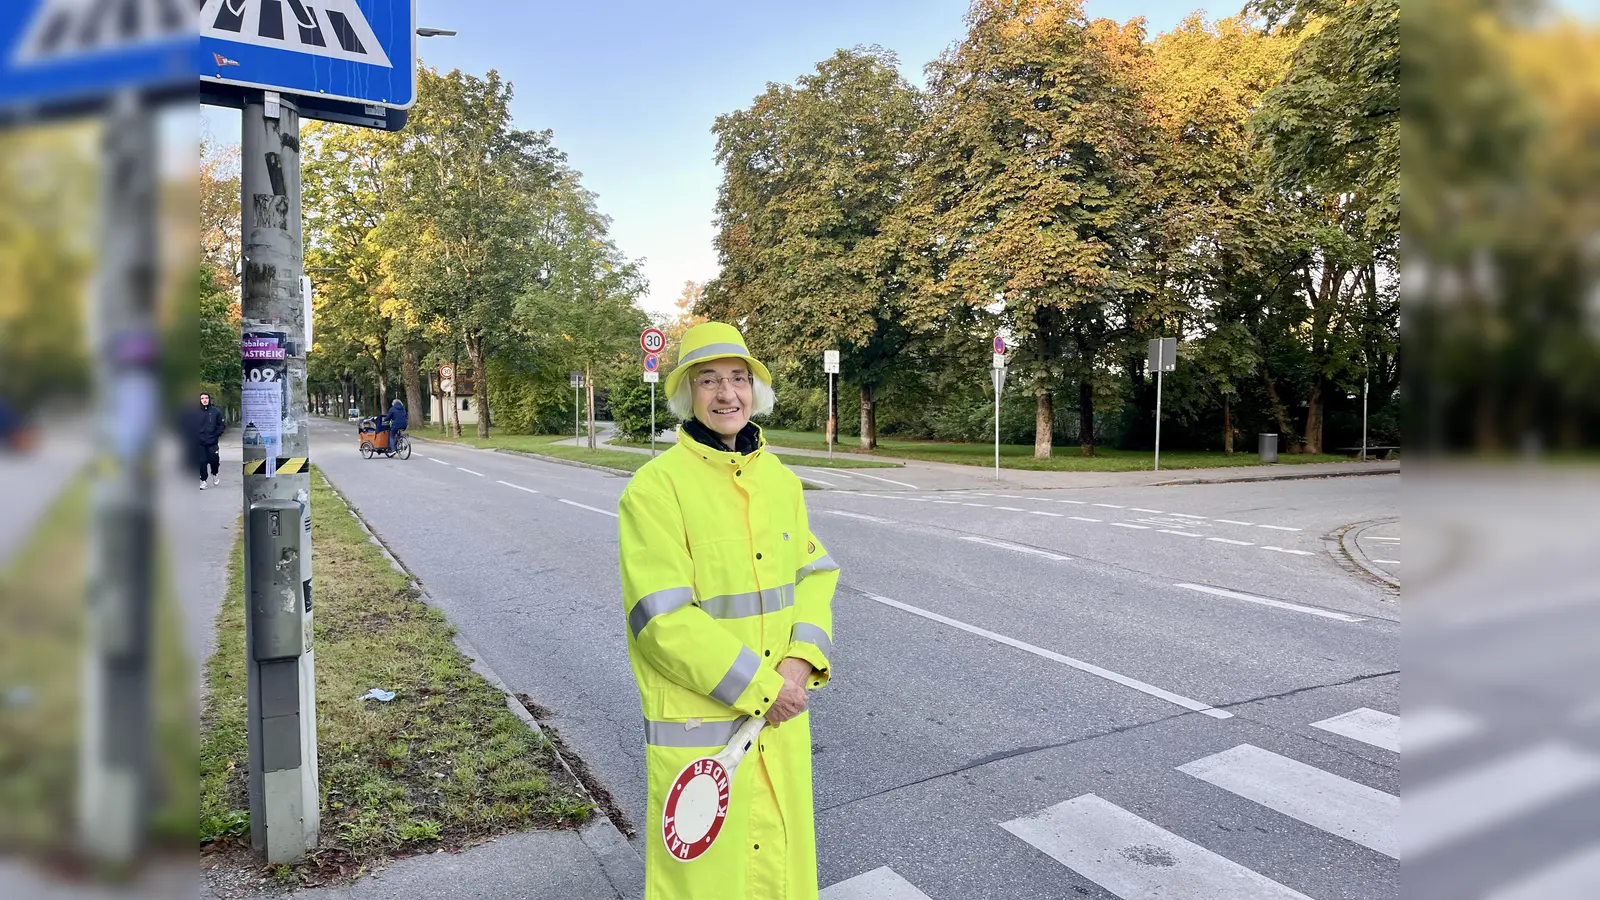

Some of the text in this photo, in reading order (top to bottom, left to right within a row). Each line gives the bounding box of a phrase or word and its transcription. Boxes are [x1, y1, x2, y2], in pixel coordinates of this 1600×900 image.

[646, 335, 661, 347] 30
[694, 760, 729, 817] KINDER
[664, 815, 690, 859] HALT
